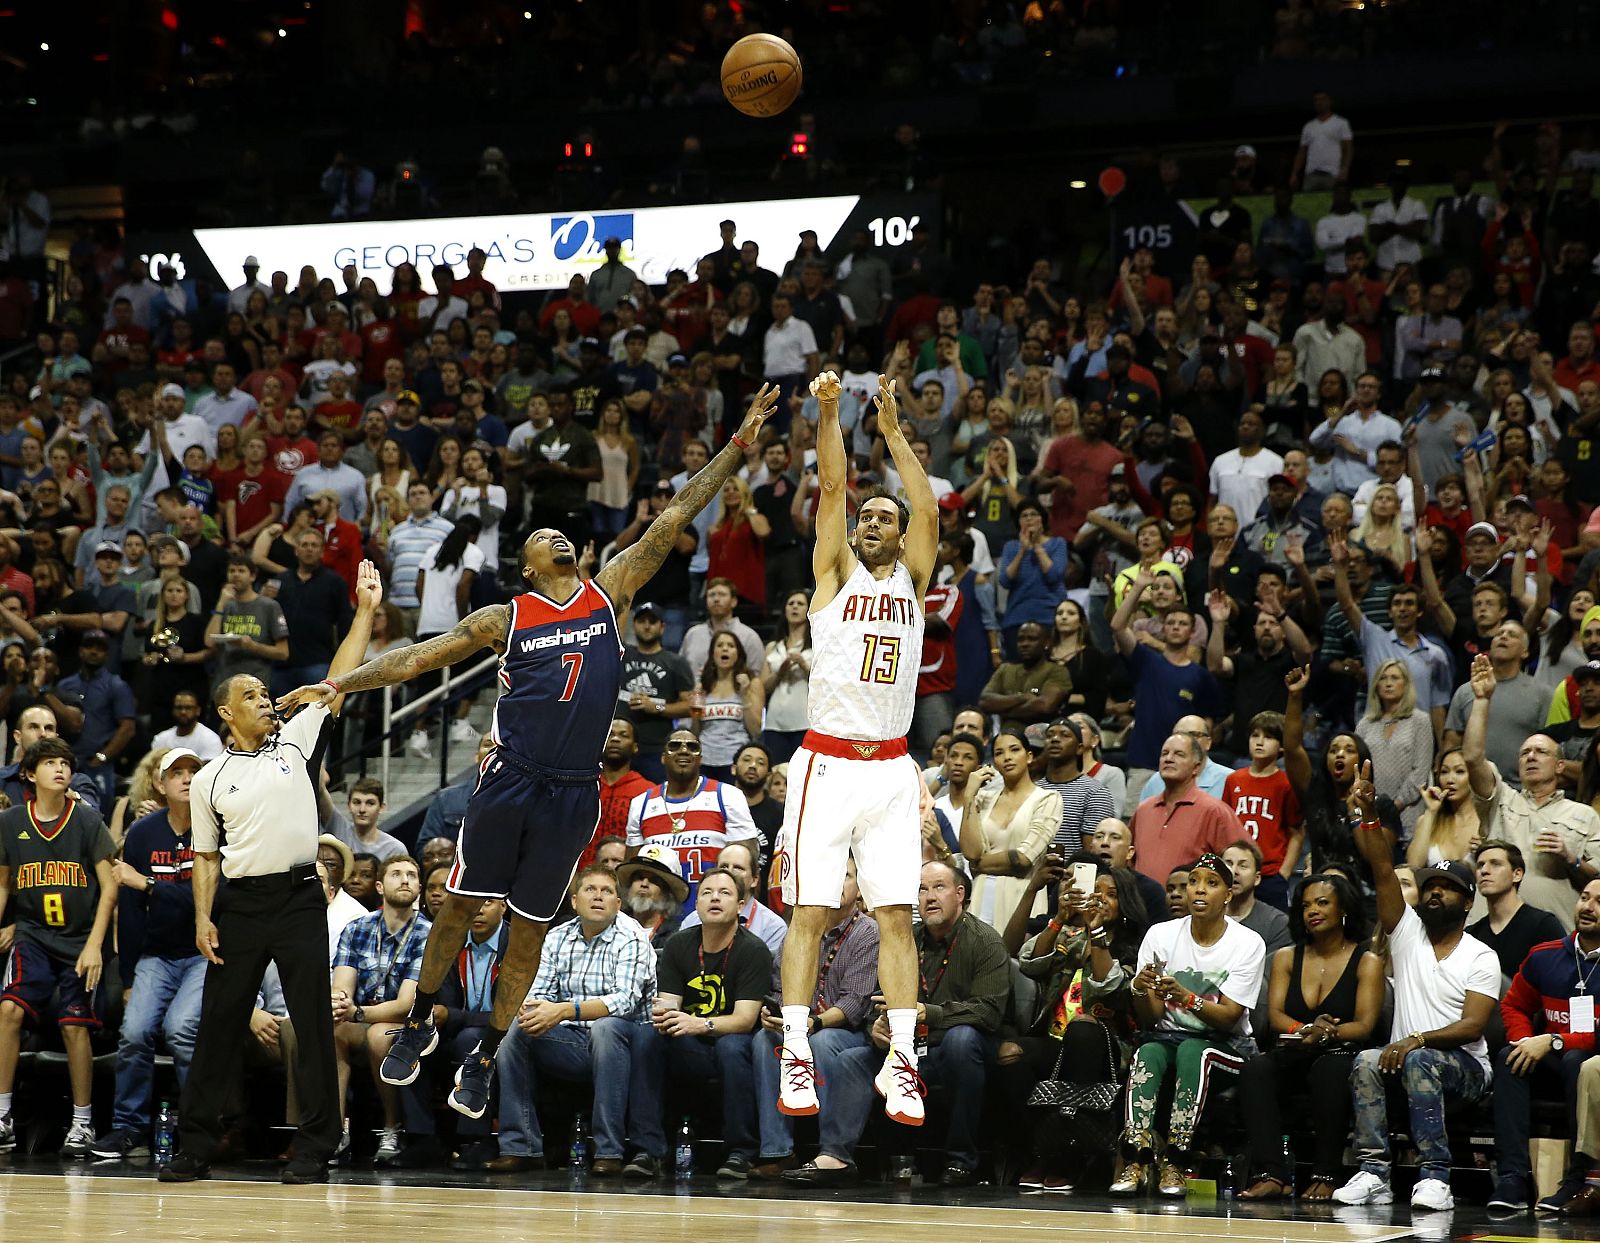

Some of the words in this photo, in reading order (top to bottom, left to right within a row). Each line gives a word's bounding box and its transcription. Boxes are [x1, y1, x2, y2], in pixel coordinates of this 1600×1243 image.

[726, 70, 778, 99] SPALDING
[1123, 224, 1172, 249] 105
[508, 272, 569, 286] CREDIT
[988, 499, 1000, 521] 8
[842, 593, 915, 628] ATLANTA
[520, 622, 607, 653] washingon
[859, 633, 901, 685] 13
[558, 652, 584, 702] 7
[1234, 796, 1274, 820] ATL
[17, 861, 87, 889] ATLANTA
[43, 892, 66, 927] 8
